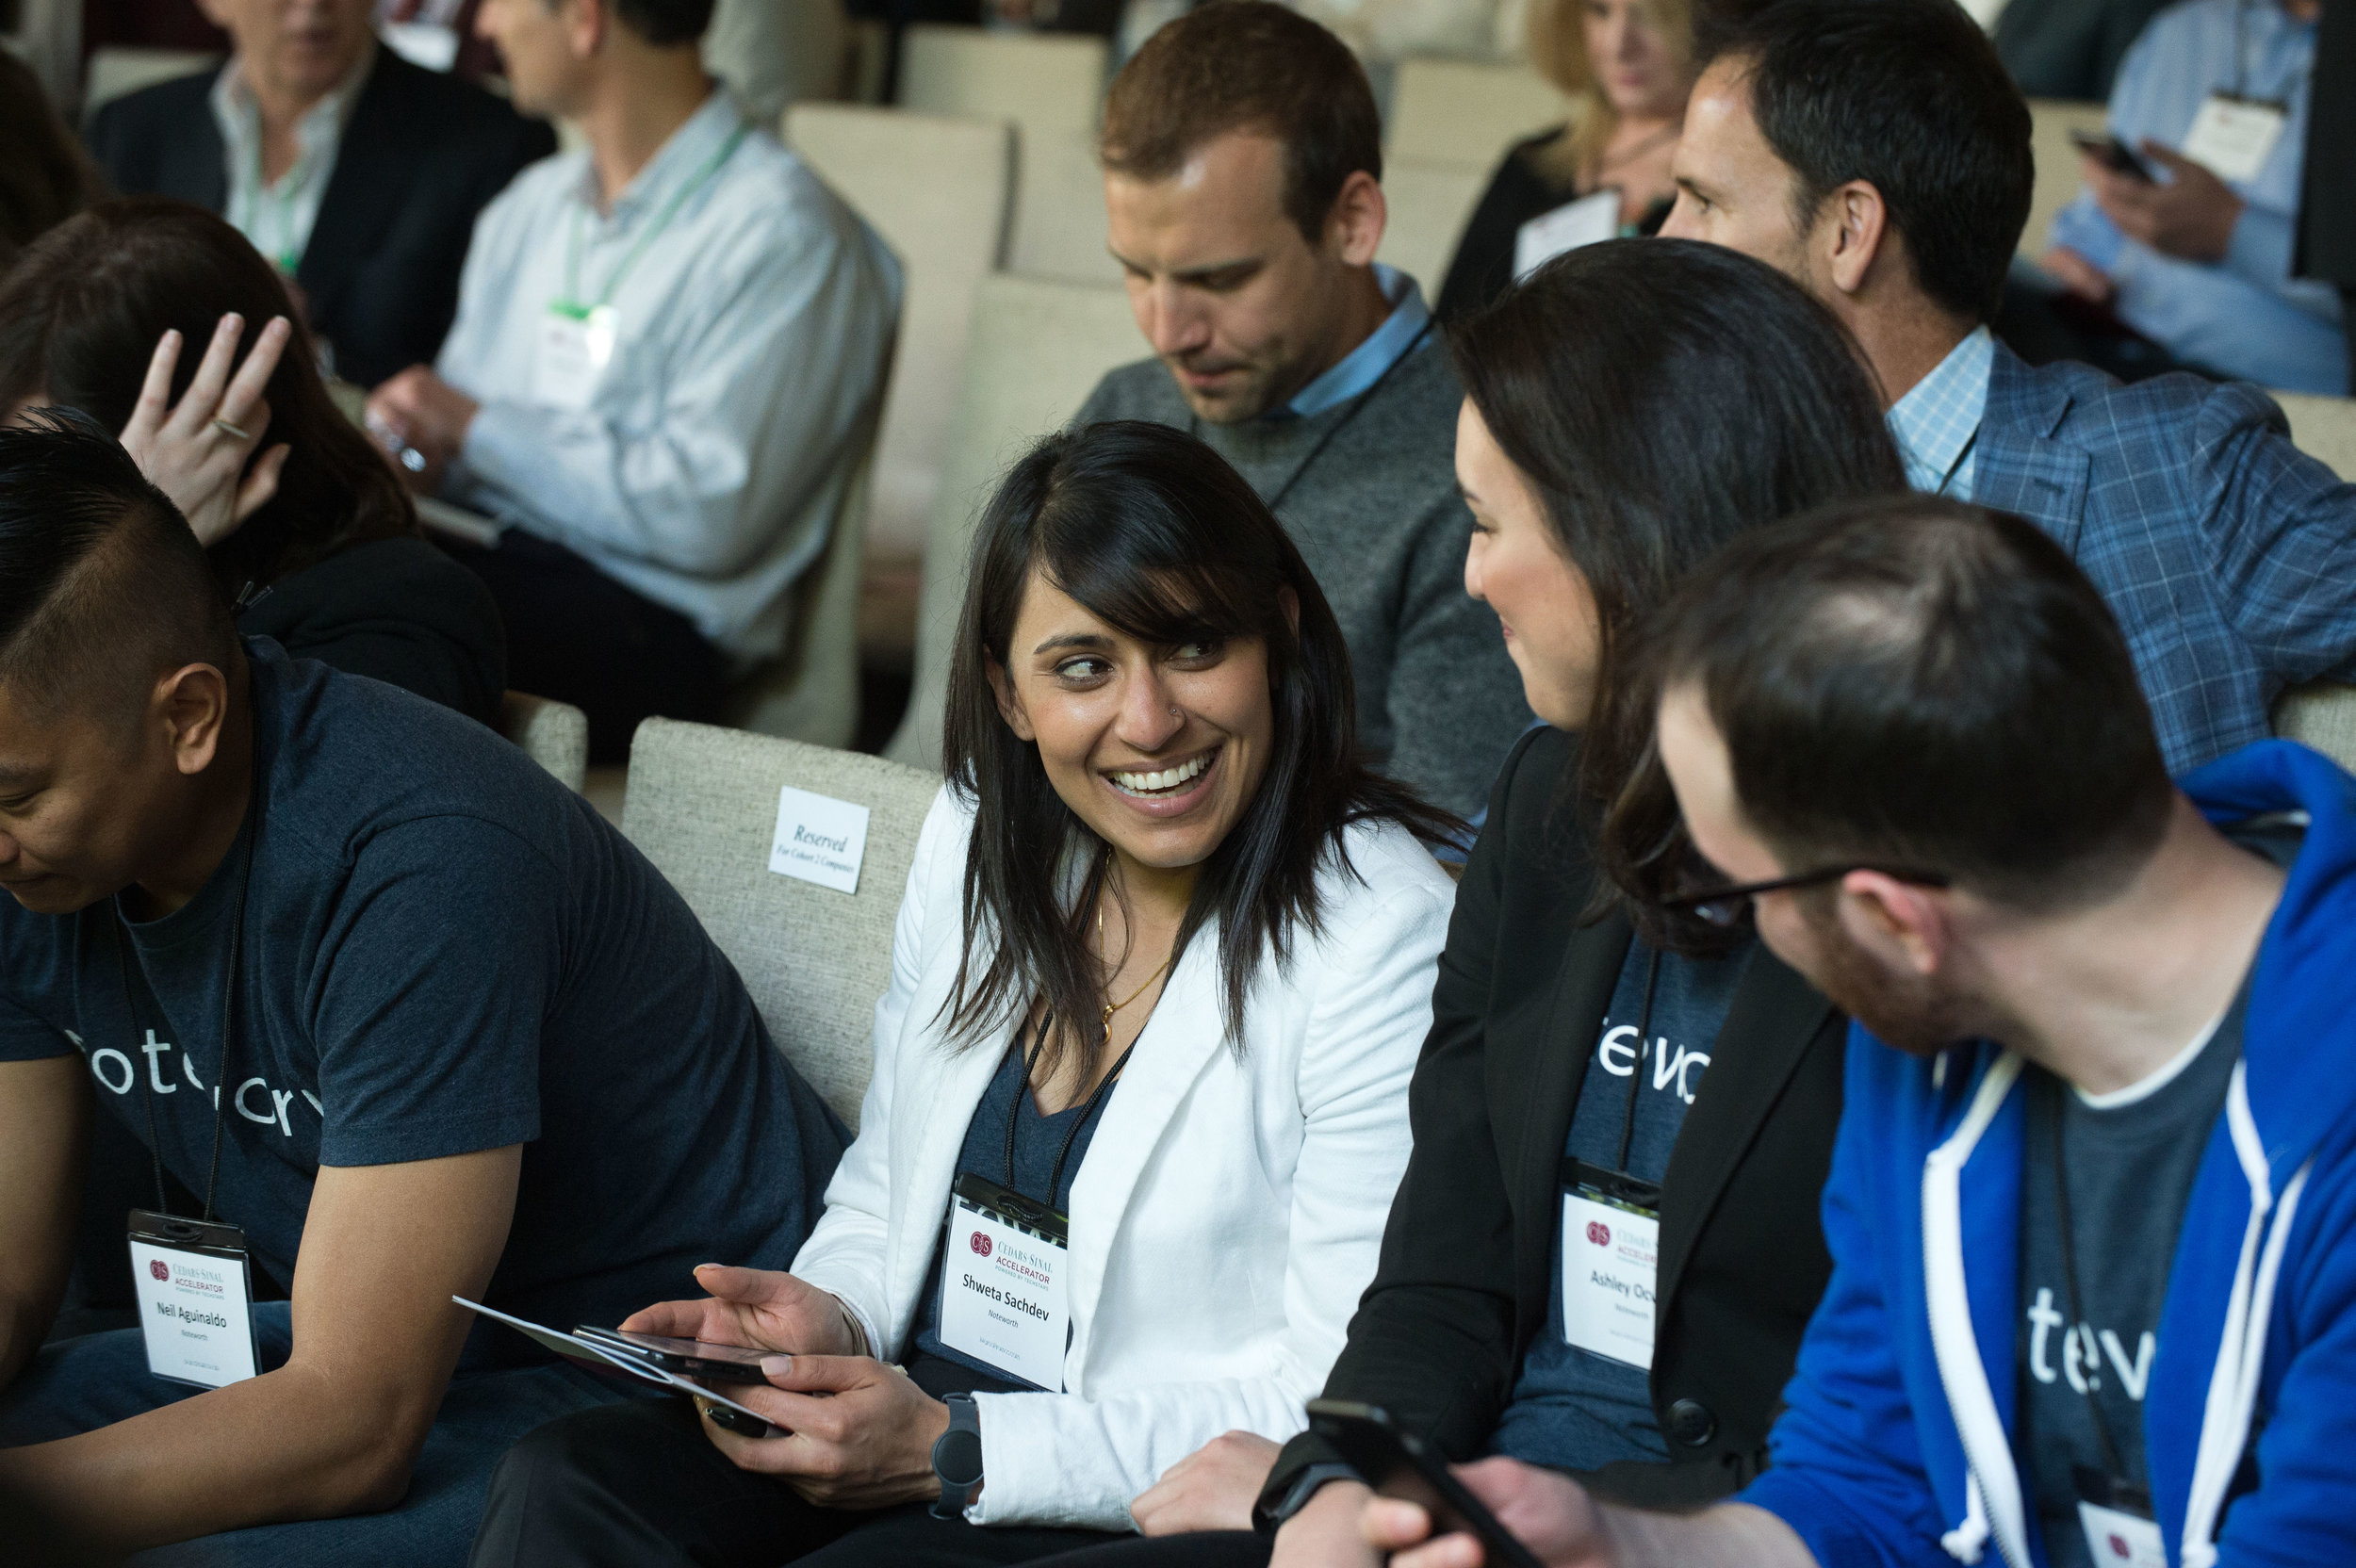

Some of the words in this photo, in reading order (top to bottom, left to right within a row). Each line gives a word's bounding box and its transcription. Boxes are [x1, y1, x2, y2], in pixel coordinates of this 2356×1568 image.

[794, 824, 848, 853] Reserved
[996, 1255, 1050, 1284] ACCELERATOR
[1590, 1269, 1630, 1298] Ashley
[175, 1278, 224, 1293] ACCELERATOR
[962, 1273, 1002, 1302] Shweta
[1004, 1291, 1050, 1321] Sachdev
[156, 1301, 176, 1317] Neil
[178, 1307, 227, 1328] Aguinaldo
[988, 1309, 1019, 1329] Noteworth
